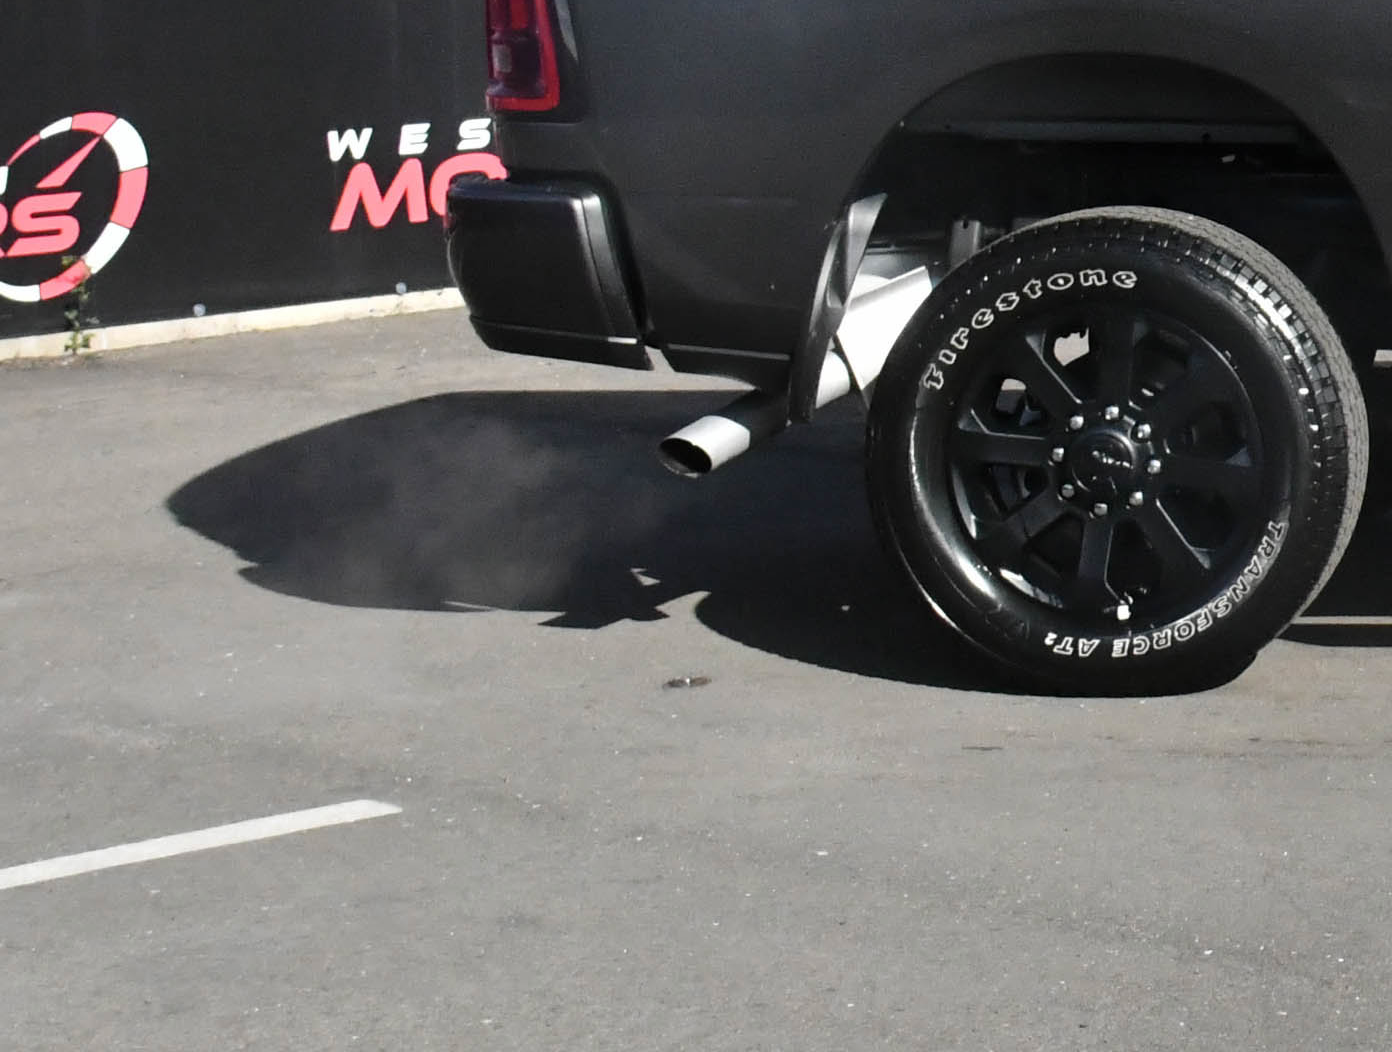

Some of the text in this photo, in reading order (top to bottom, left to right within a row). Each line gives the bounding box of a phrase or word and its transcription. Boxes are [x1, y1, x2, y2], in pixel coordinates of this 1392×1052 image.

[326, 117, 492, 162] WES
[923, 268, 1138, 390] Firestone
[1111, 520, 1288, 659] TRANSFORCE
